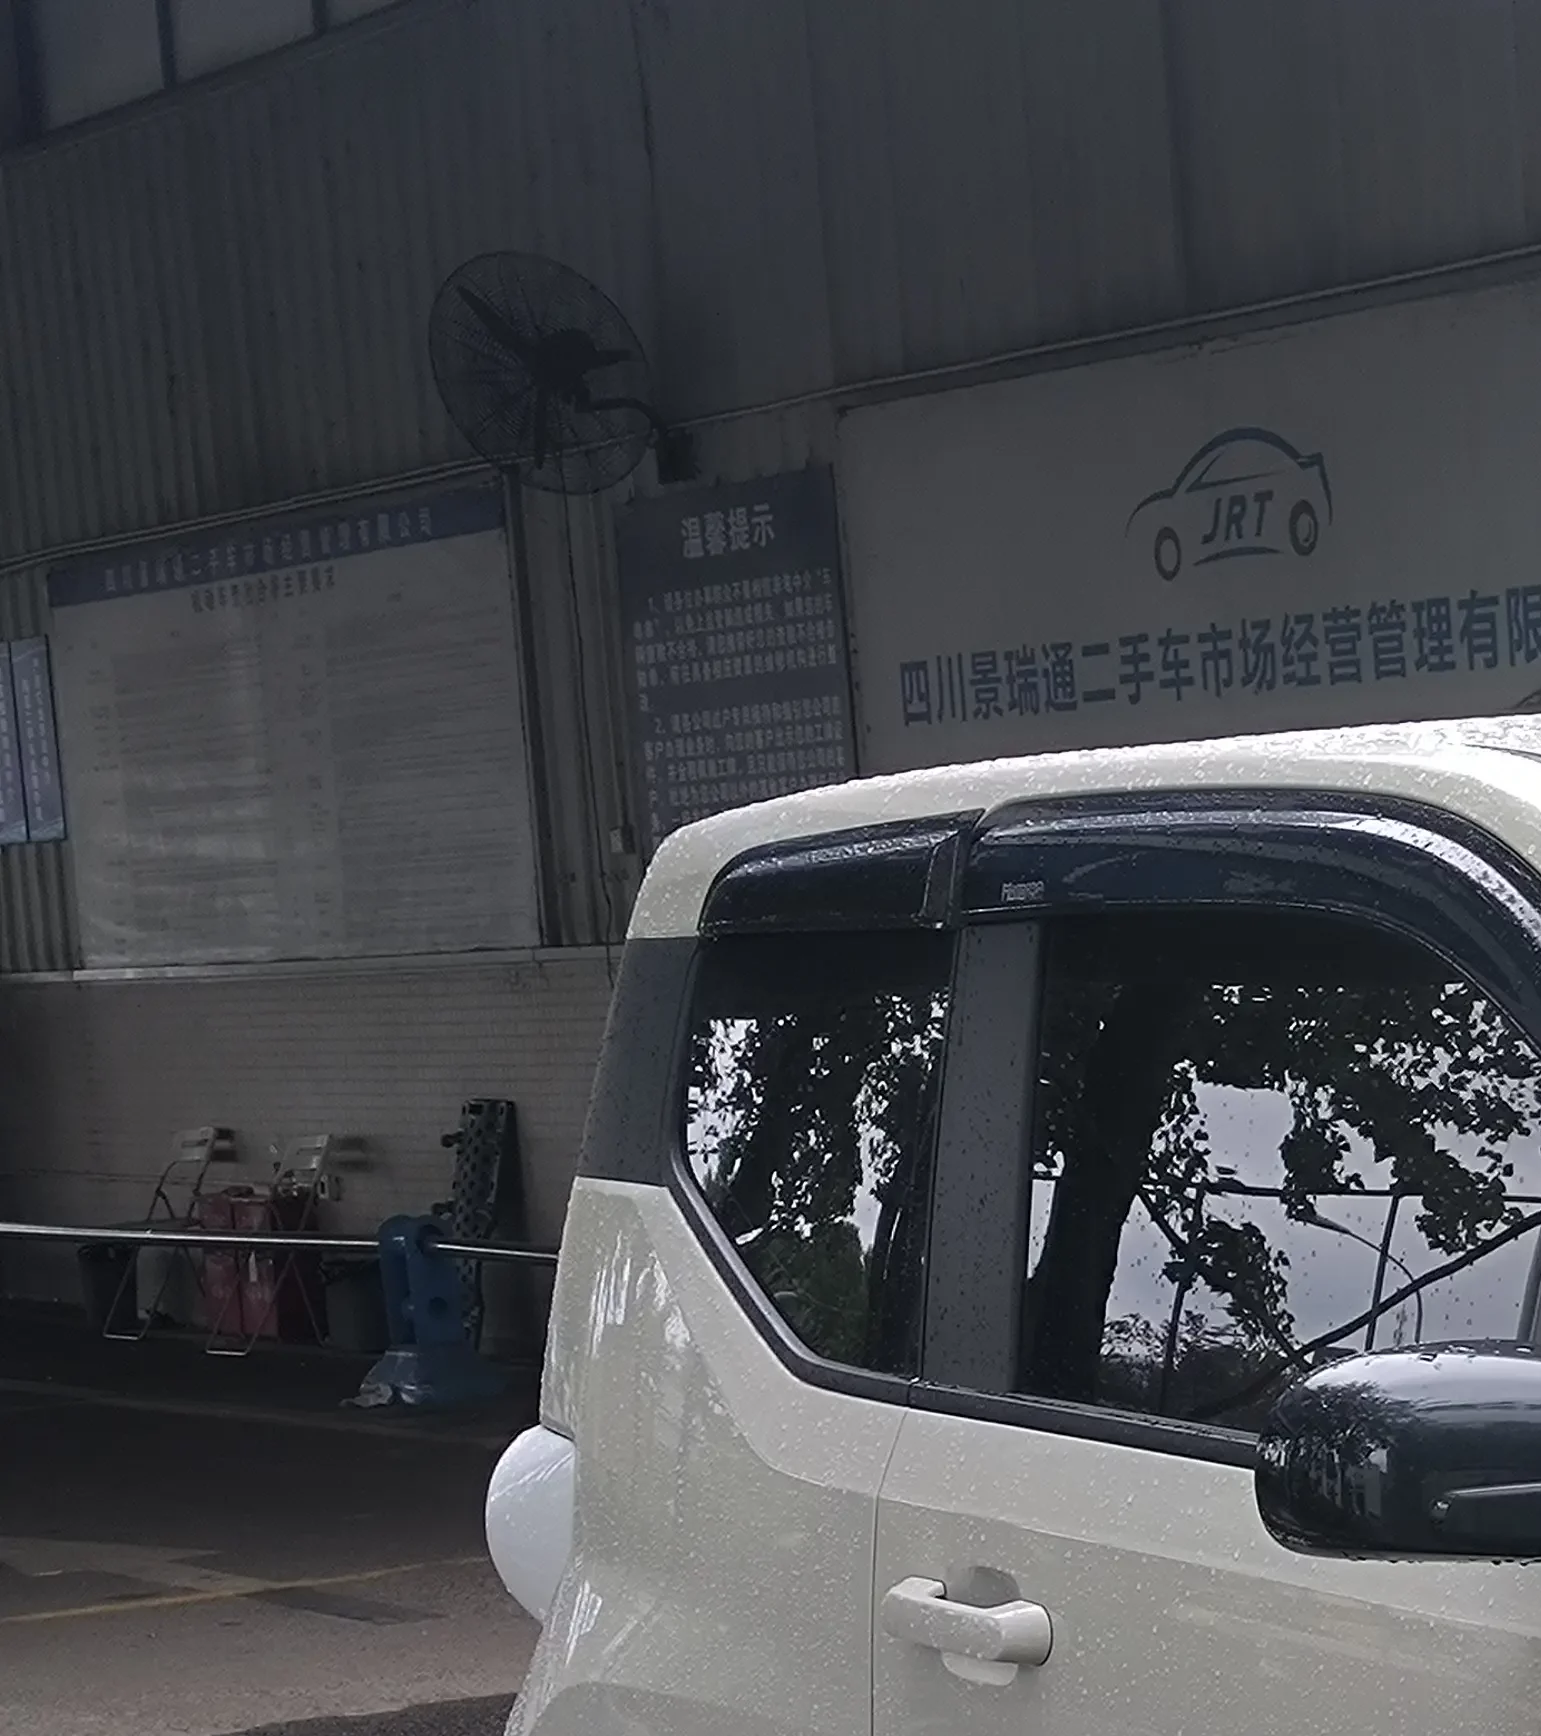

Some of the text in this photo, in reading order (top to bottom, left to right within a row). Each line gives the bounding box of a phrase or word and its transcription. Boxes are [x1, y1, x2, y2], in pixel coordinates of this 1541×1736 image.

[680, 502, 776, 559] 温馨提示
[1200, 490, 1275, 548] JRT
